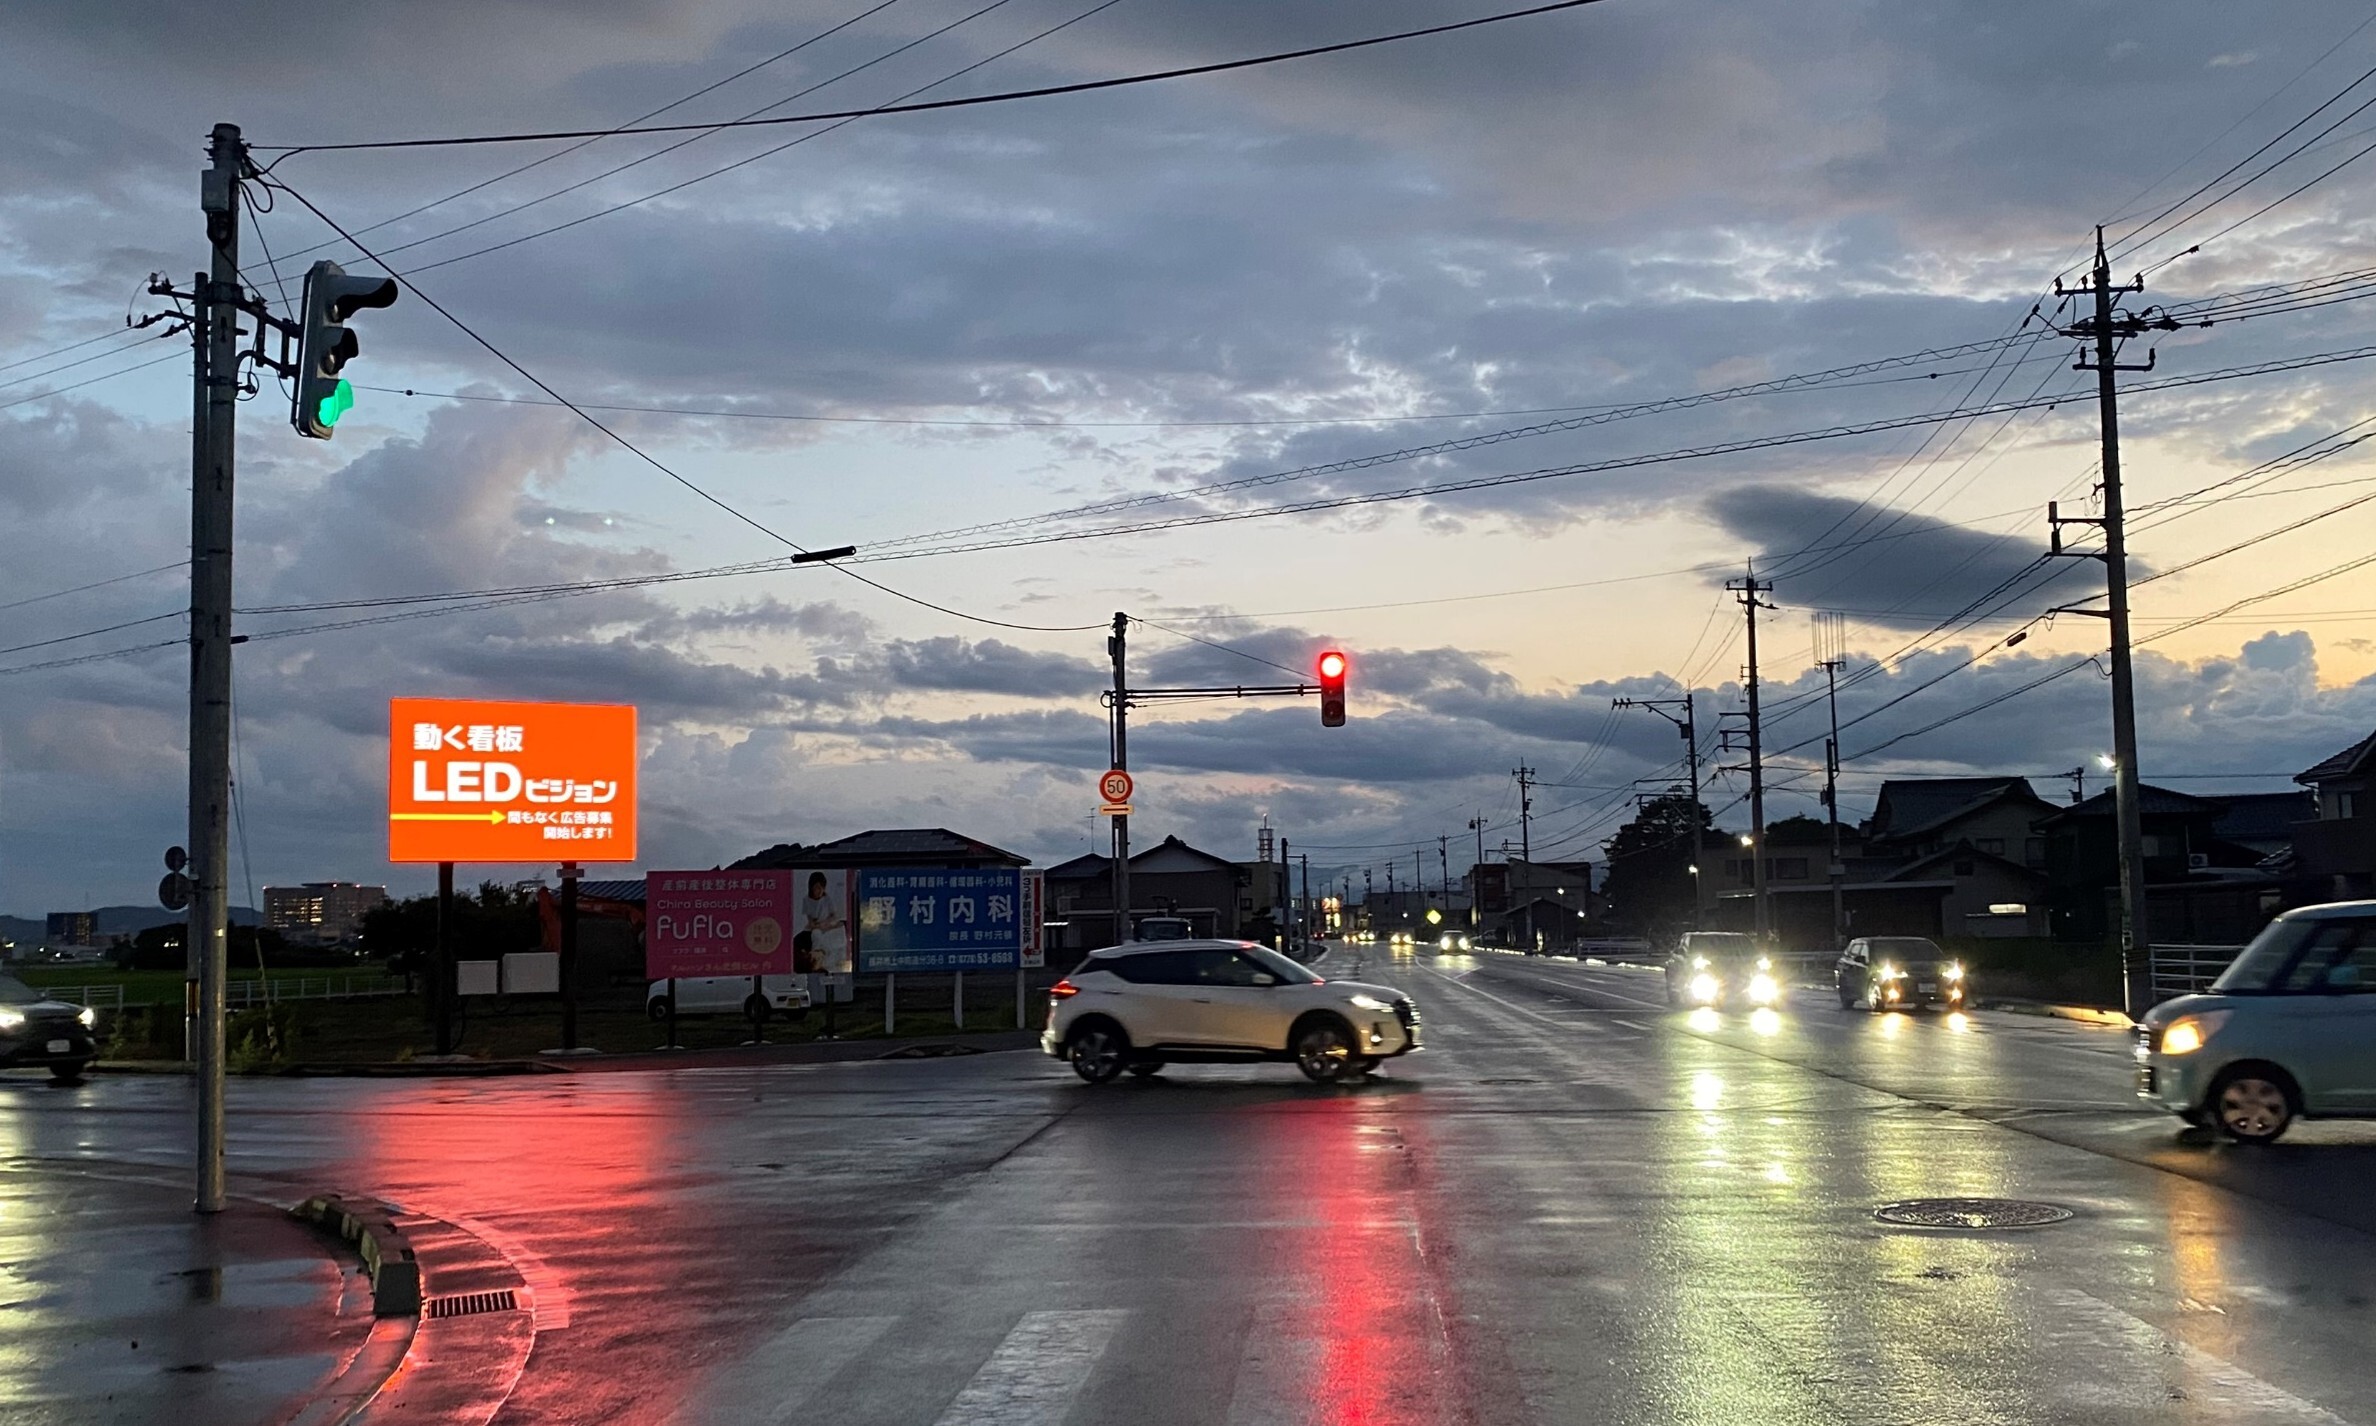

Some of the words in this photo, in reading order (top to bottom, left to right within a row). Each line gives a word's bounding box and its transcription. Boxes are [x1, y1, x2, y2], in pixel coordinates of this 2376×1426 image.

[413, 723, 524, 752] 動く看板
[1107, 779, 1125, 793] 50
[657, 899, 691, 909] Chiro
[695, 898, 738, 911] Beauty
[741, 898, 773, 908] Salon
[869, 895, 1012, 924] 野村内科
